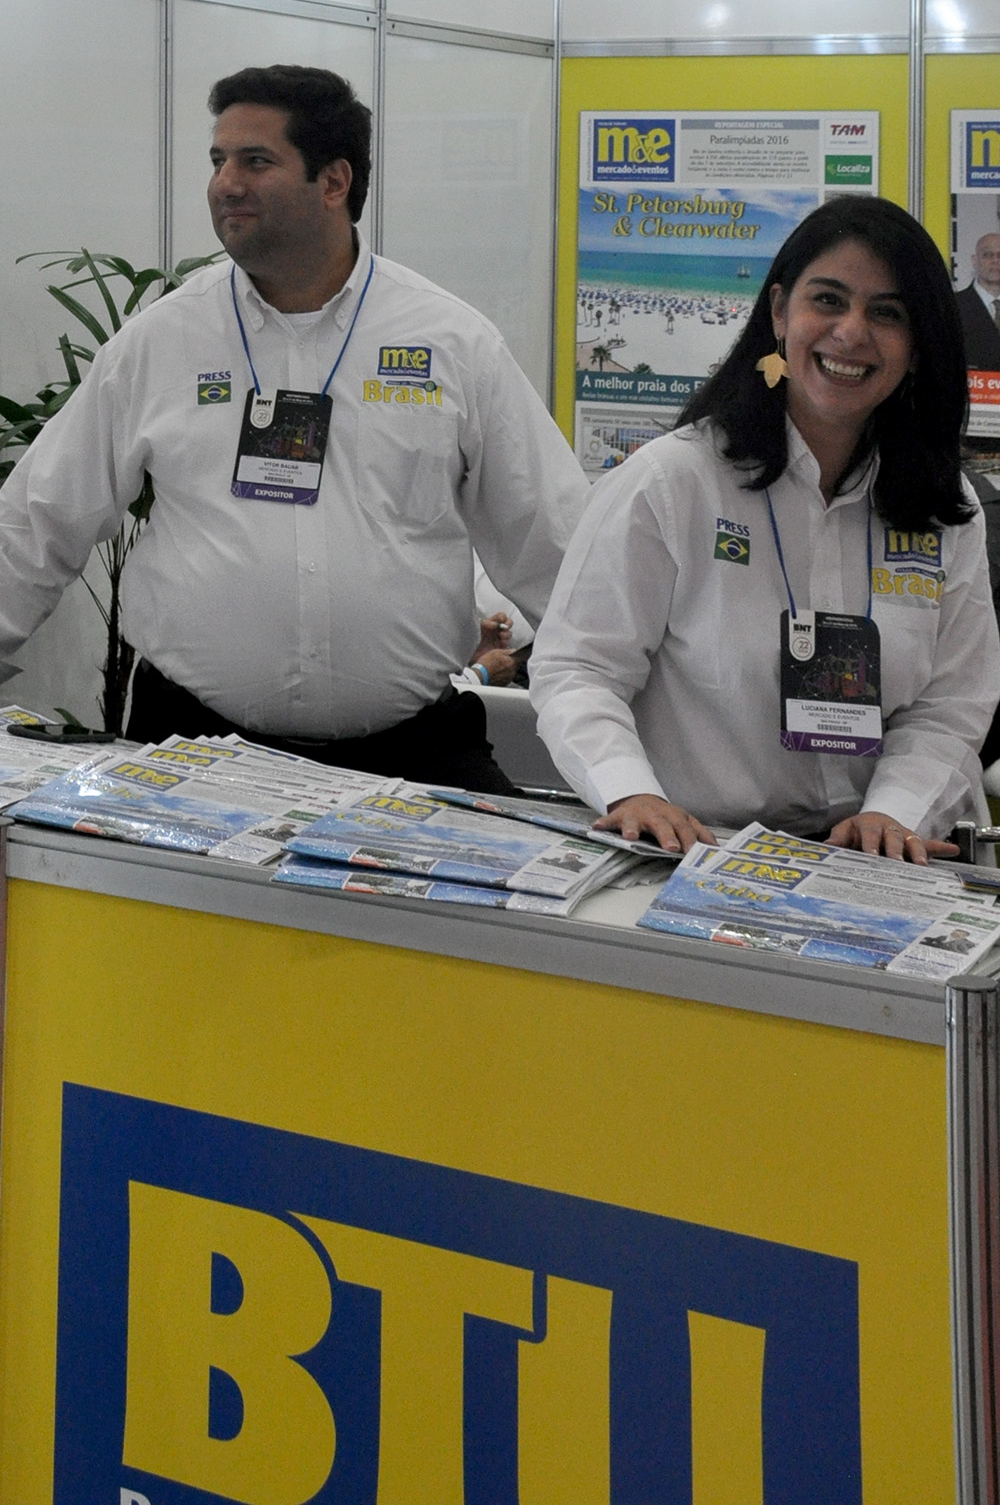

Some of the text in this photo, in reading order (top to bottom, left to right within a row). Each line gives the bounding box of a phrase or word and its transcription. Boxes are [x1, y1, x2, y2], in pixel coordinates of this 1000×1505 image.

[831, 124, 866, 136] TAM
[598, 127, 671, 164] m&e
[766, 135, 789, 145] 2016
[598, 164, 669, 174] mercado&eventos
[837, 164, 870, 174] Localiza
[592, 192, 746, 220] St. Petersburg
[612, 216, 760, 240] & Clearwater
[382, 348, 429, 370] m&e
[198, 370, 232, 382] PRESS
[968, 376, 984, 388] ois
[582, 375, 591, 388] A
[594, 376, 634, 390] melhor
[637, 380, 666, 393] praia
[670, 380, 691, 394] dos
[363, 379, 443, 406] Brasil
[255, 488, 294, 499] EXPOSITOR
[716, 517, 750, 537] PRESS
[793, 624, 812, 632] BNT
[802, 705, 866, 716] LUCIANA FERNANDES
[811, 738, 856, 750] EXPOSITOR
